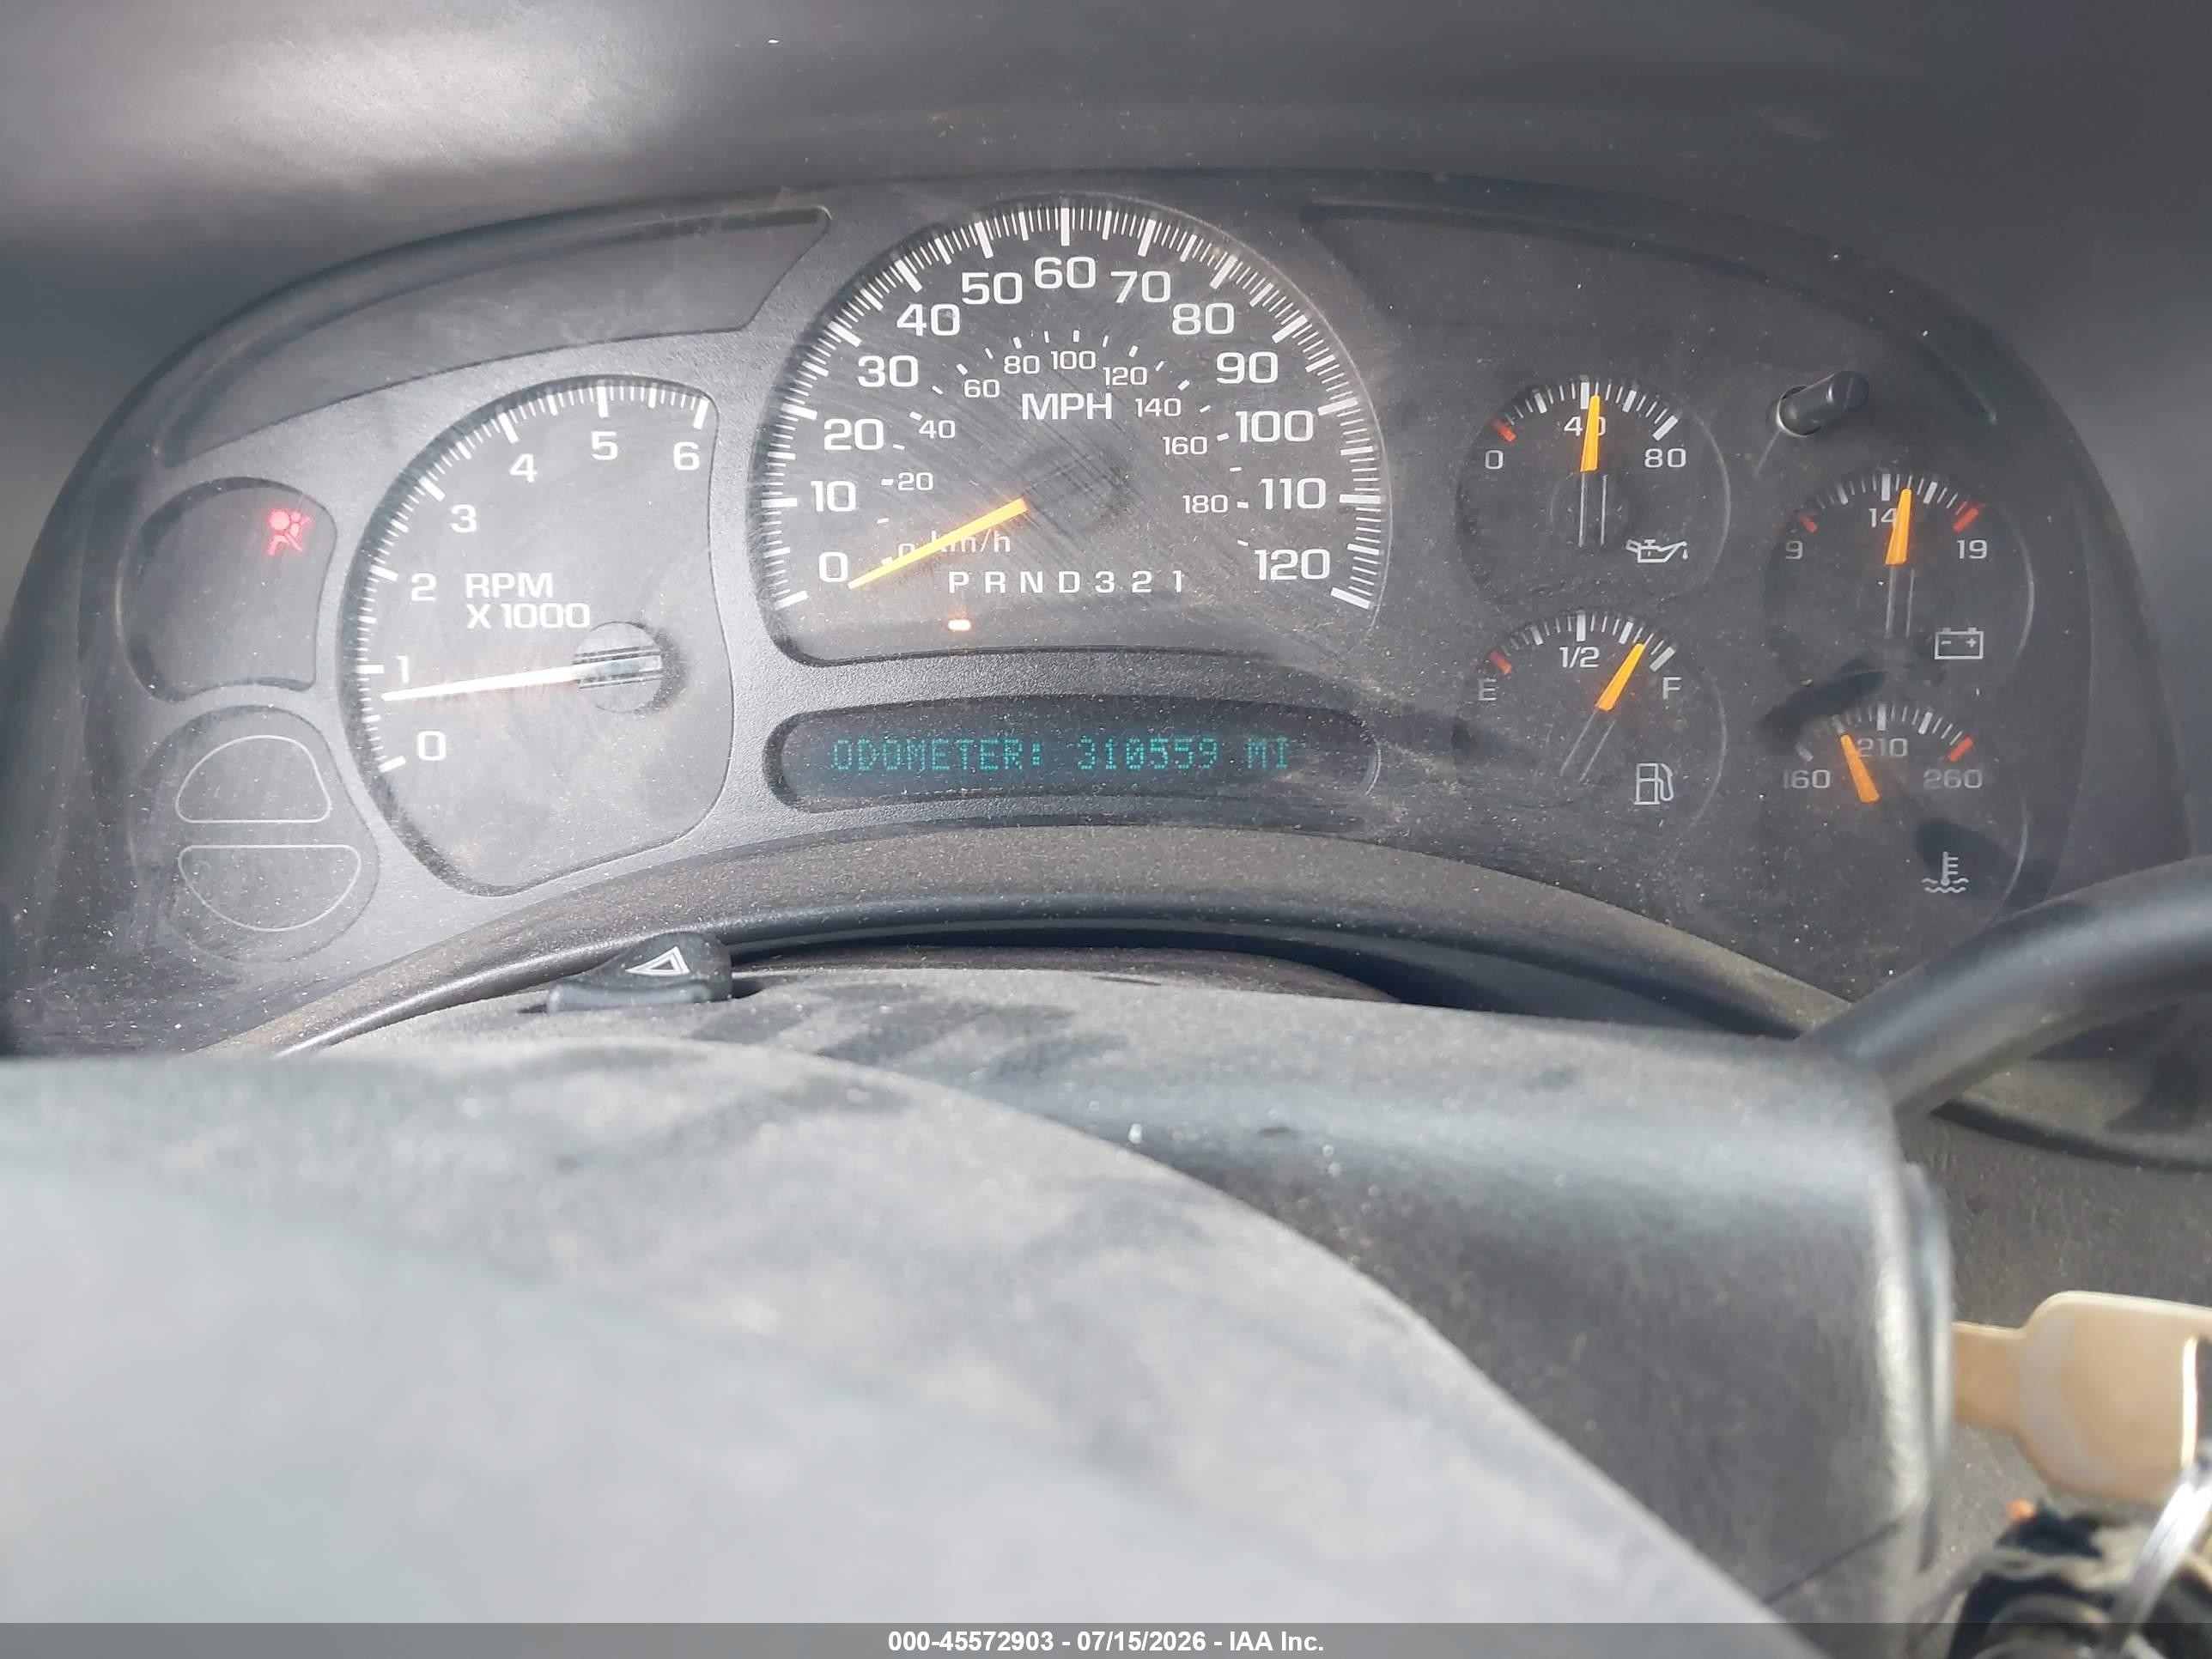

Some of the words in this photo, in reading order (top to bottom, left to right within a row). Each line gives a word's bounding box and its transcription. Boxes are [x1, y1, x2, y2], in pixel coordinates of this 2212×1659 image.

[1034, 257, 1096, 289] 60
[961, 271, 1023, 305] 50
[1111, 270, 1171, 304] 70
[896, 304, 960, 337] 40
[1172, 302, 1235, 335] 80
[858, 356, 918, 388] 30
[1004, 356, 1040, 374] 80
[1051, 350, 1096, 369] 100
[1216, 351, 1279, 384] 90
[963, 379, 1000, 398] 60
[1103, 367, 1147, 386] 120
[1023, 393, 1111, 420] MPH
[1135, 398, 1181, 417] 140
[823, 418, 883, 451] 20
[918, 420, 955, 439] 40
[1237, 410, 1315, 443] 100
[592, 431, 617, 460] 5
[673, 442, 700, 471] 6
[1163, 436, 1208, 456] 160
[1644, 448, 1686, 467] 80
[510, 453, 538, 483] 4
[1485, 450, 1503, 470] 0
[898, 472, 933, 491] 20
[1260, 477, 1326, 509] 110
[811, 480, 856, 512] 10
[1183, 494, 1228, 514] 180
[451, 504, 477, 532] 3
[1869, 508, 1898, 527] 14
[1785, 540, 1802, 559] 9
[1957, 540, 1987, 558] 19
[819, 551, 848, 583] 0
[1255, 548, 1330, 580] 120
[410, 574, 436, 601] 2
[465, 573, 553, 598] RPM
[949, 572, 969, 593] P
[985, 572, 1006, 593] R
[1020, 571, 1042, 593] N
[1059, 571, 1080, 593] D
[1096, 571, 1115, 593] 3
[1132, 571, 1152, 592] 2
[1173, 570, 1182, 592] 1
[467, 604, 490, 629] X
[501, 604, 590, 629] 1000
[398, 655, 409, 684] 1
[1559, 647, 1600, 668] 1/2
[1479, 679, 1497, 701] E
[1662, 678, 1681, 699] F
[417, 731, 446, 761] 0
[832, 739, 1041, 771] ODOMETER:
[1079, 738, 1218, 769] 310559
[1247, 737, 1288, 769] MI
[1856, 738, 1908, 758] 210
[1784, 769, 1832, 790] 160
[1923, 769, 1983, 790] 260
